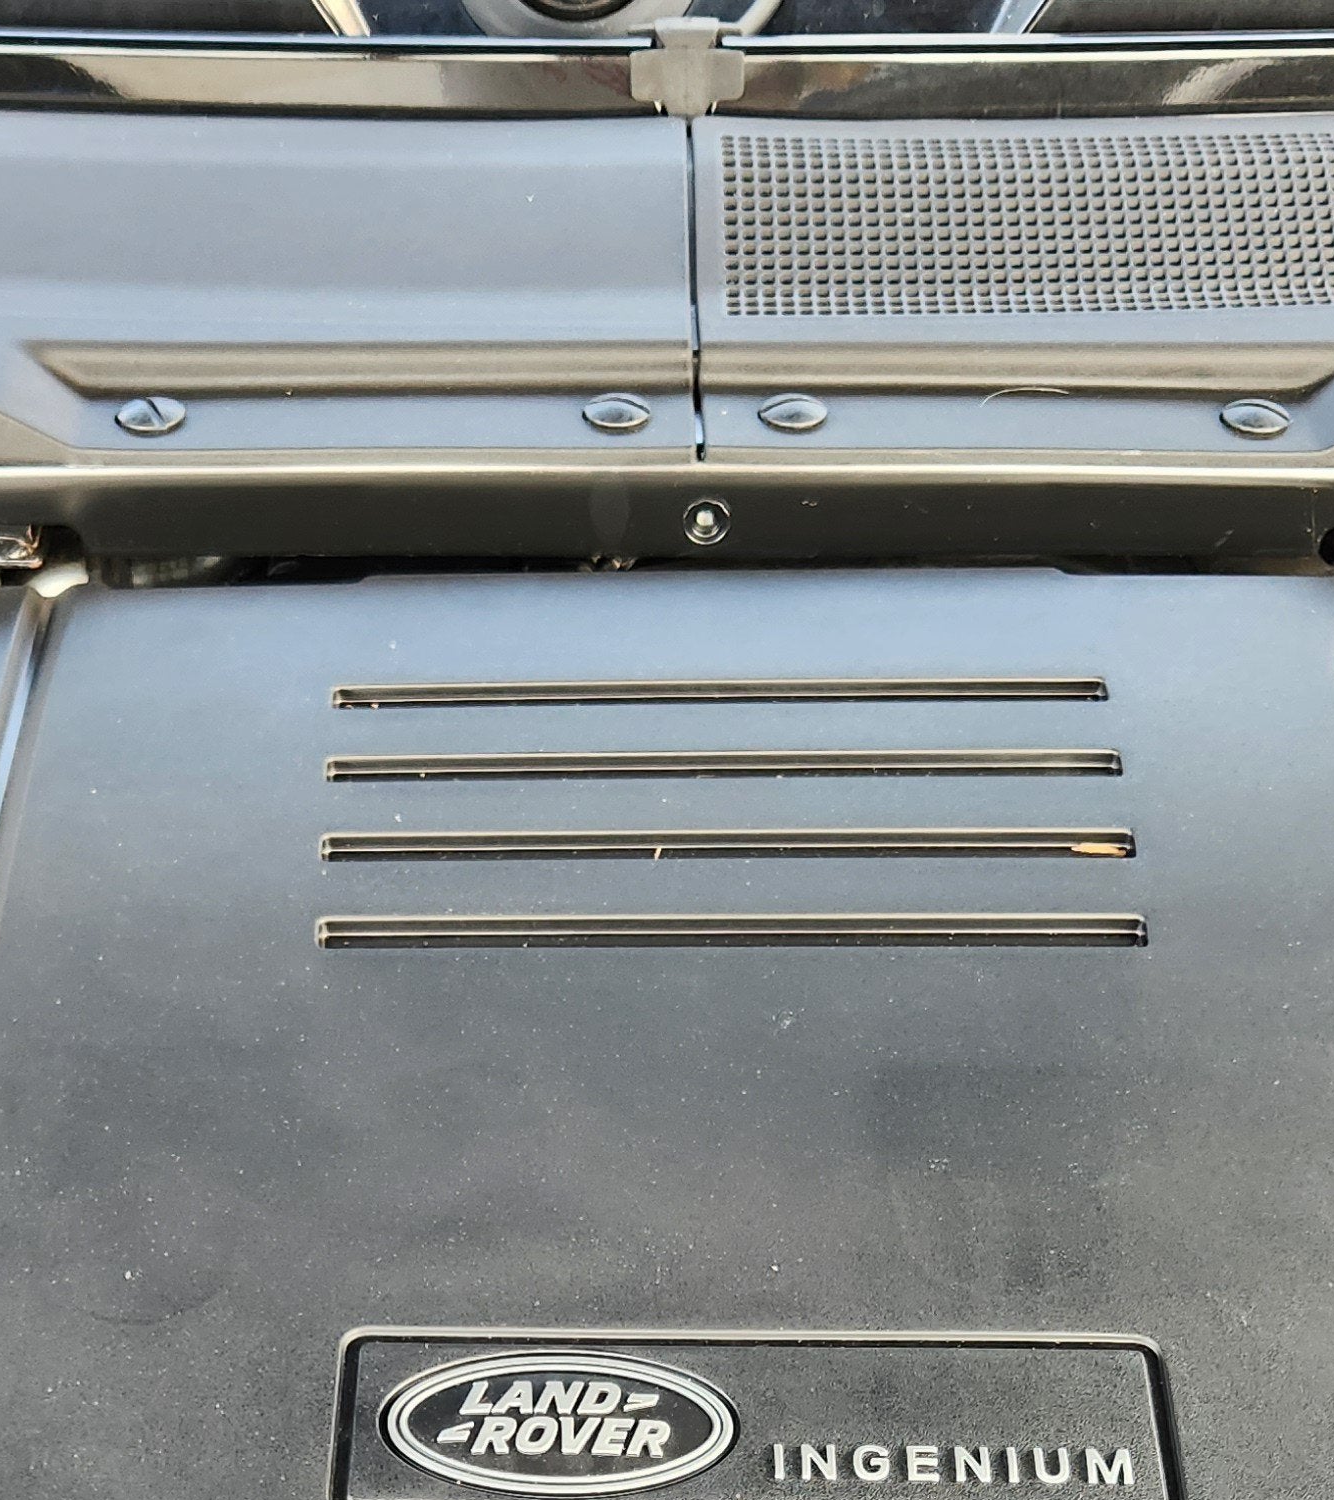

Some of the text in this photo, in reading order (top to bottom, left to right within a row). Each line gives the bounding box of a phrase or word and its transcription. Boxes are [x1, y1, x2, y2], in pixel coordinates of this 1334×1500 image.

[459, 1379, 622, 1416] LAND
[470, 1416, 671, 1459] ROVER
[772, 1443, 1135, 1486] INGENIUM
